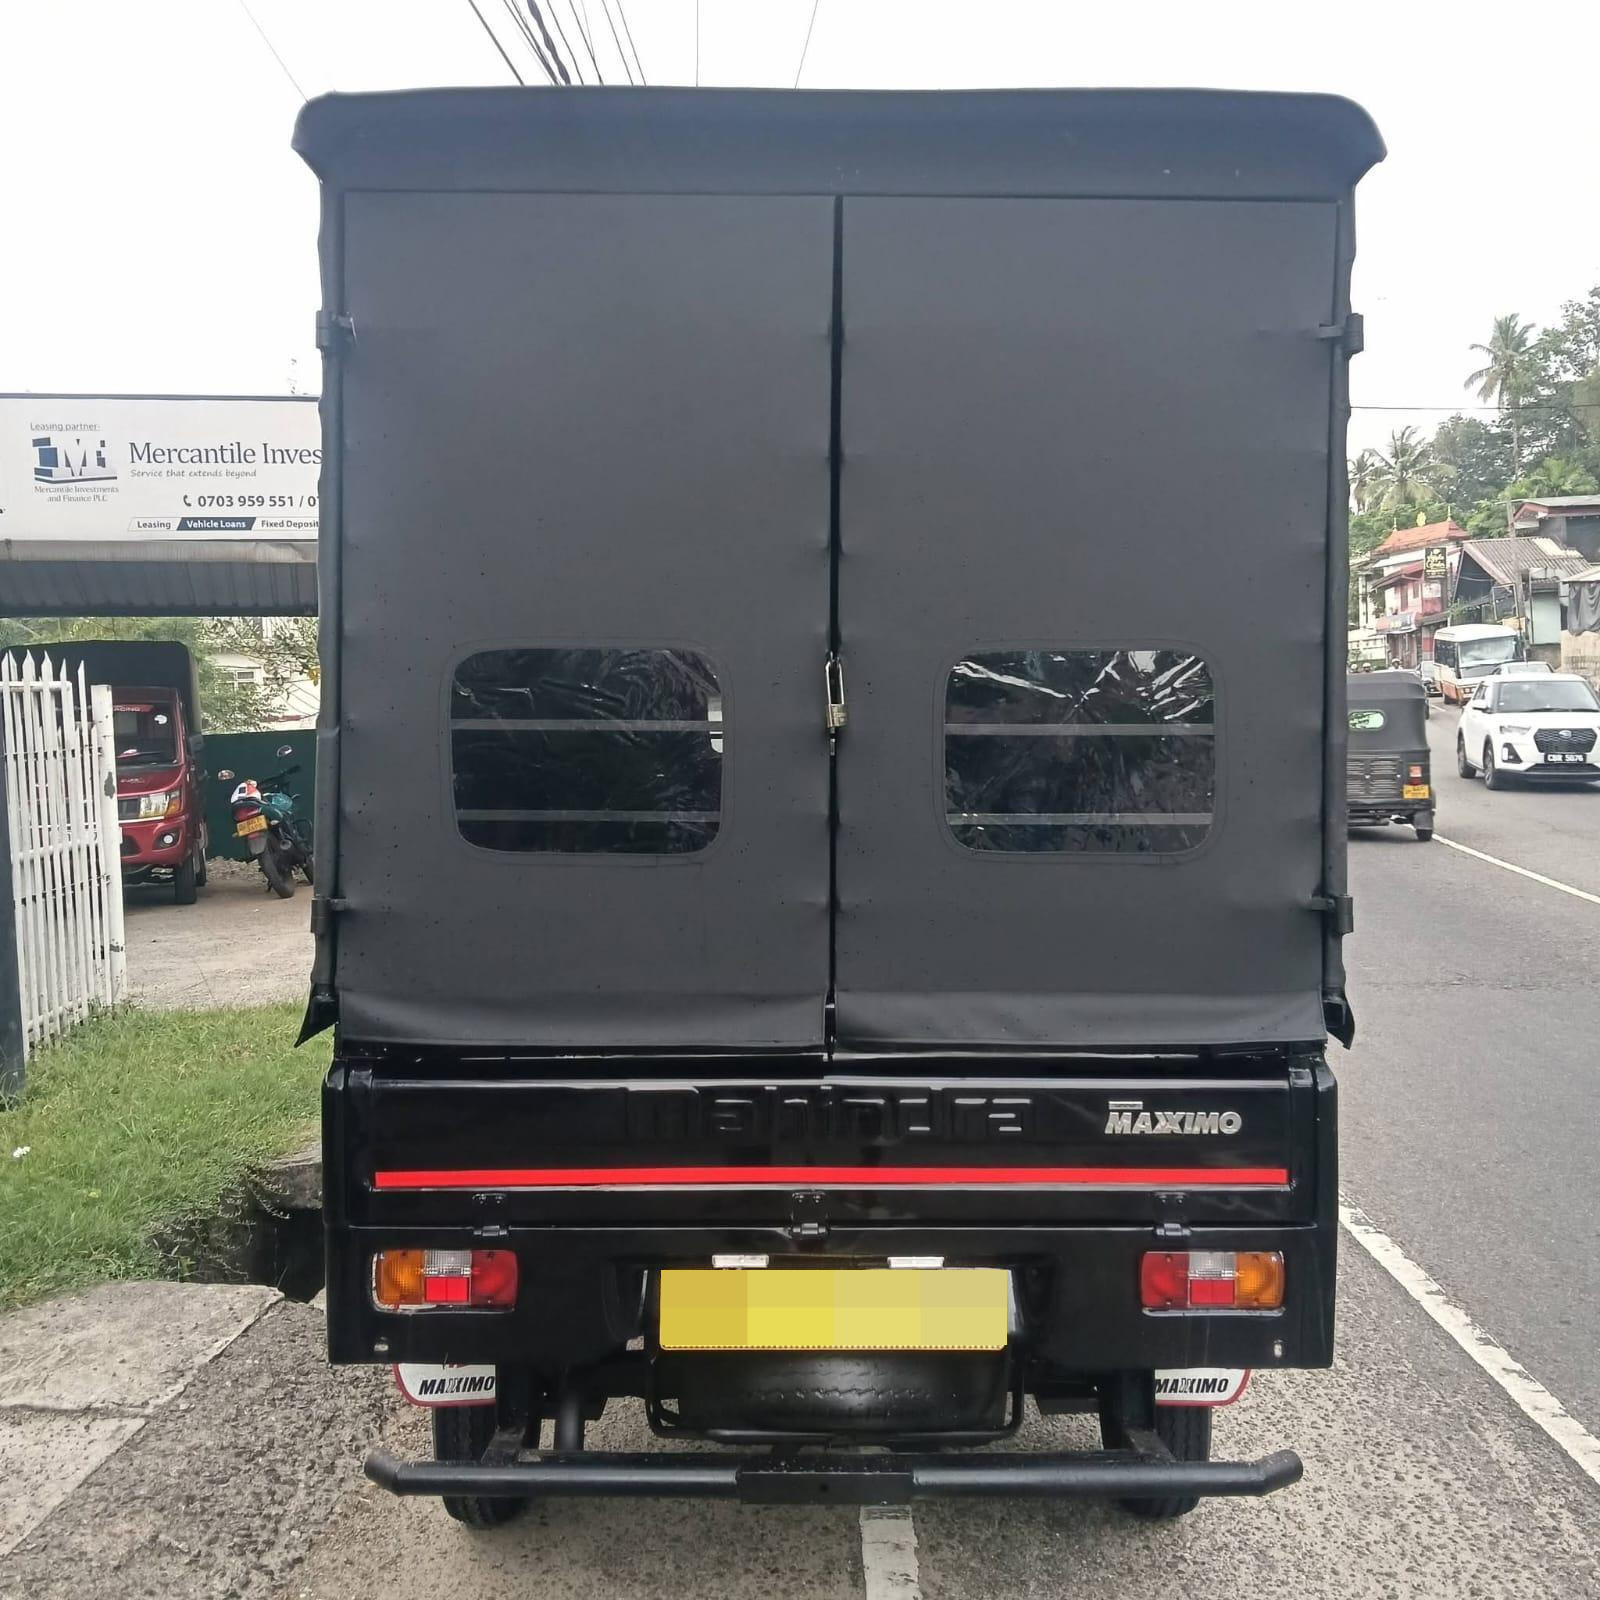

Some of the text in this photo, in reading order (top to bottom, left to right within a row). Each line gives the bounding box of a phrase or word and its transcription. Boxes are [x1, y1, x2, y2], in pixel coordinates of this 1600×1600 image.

[30, 422, 63, 431] Leasing
[129, 442, 256, 464] Mercantile
[130, 469, 257, 479] Service that extends beyond
[47, 494, 61, 502] and
[93, 494, 107, 502] PLC
[197, 495, 234, 507] 0703
[237, 495, 265, 507] 959
[268, 495, 294, 507] 551
[137, 521, 171, 530] Leasing
[187, 520, 247, 529] Vehicle Loans
[261, 520, 284, 528] Fixed
